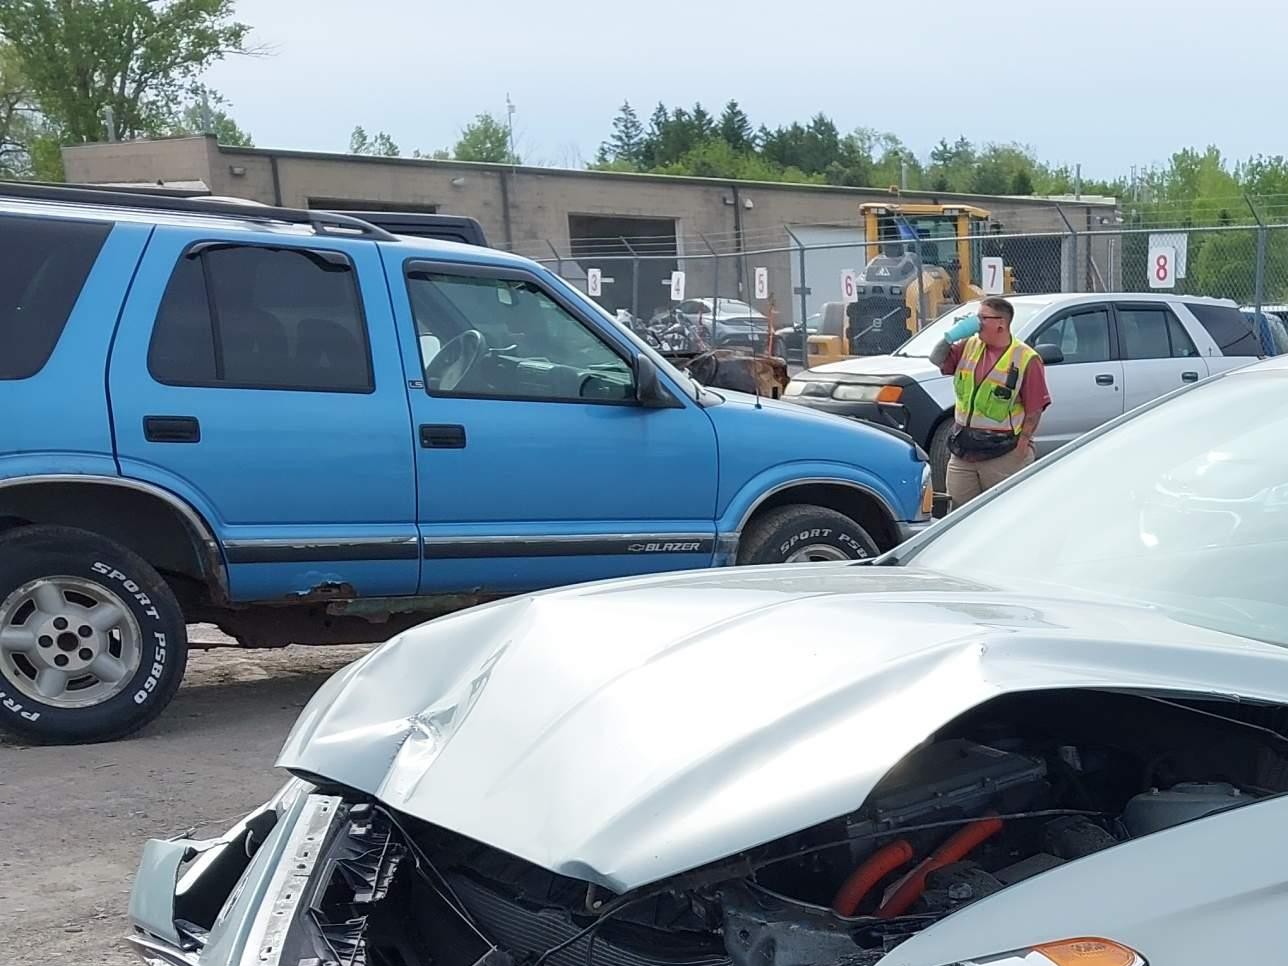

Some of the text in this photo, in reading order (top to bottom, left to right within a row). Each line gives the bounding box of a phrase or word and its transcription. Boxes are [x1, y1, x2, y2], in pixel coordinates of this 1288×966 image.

[987, 264, 997, 289] 7
[1155, 254, 1168, 281] 8
[591, 273, 598, 292] 3
[673, 276, 682, 295] 4
[758, 273, 764, 293] 5
[844, 275, 853, 297] 6
[644, 542, 702, 552] BLAZER
[780, 528, 833, 555] SPORT
[90, 561, 167, 705] SPORT PS860
